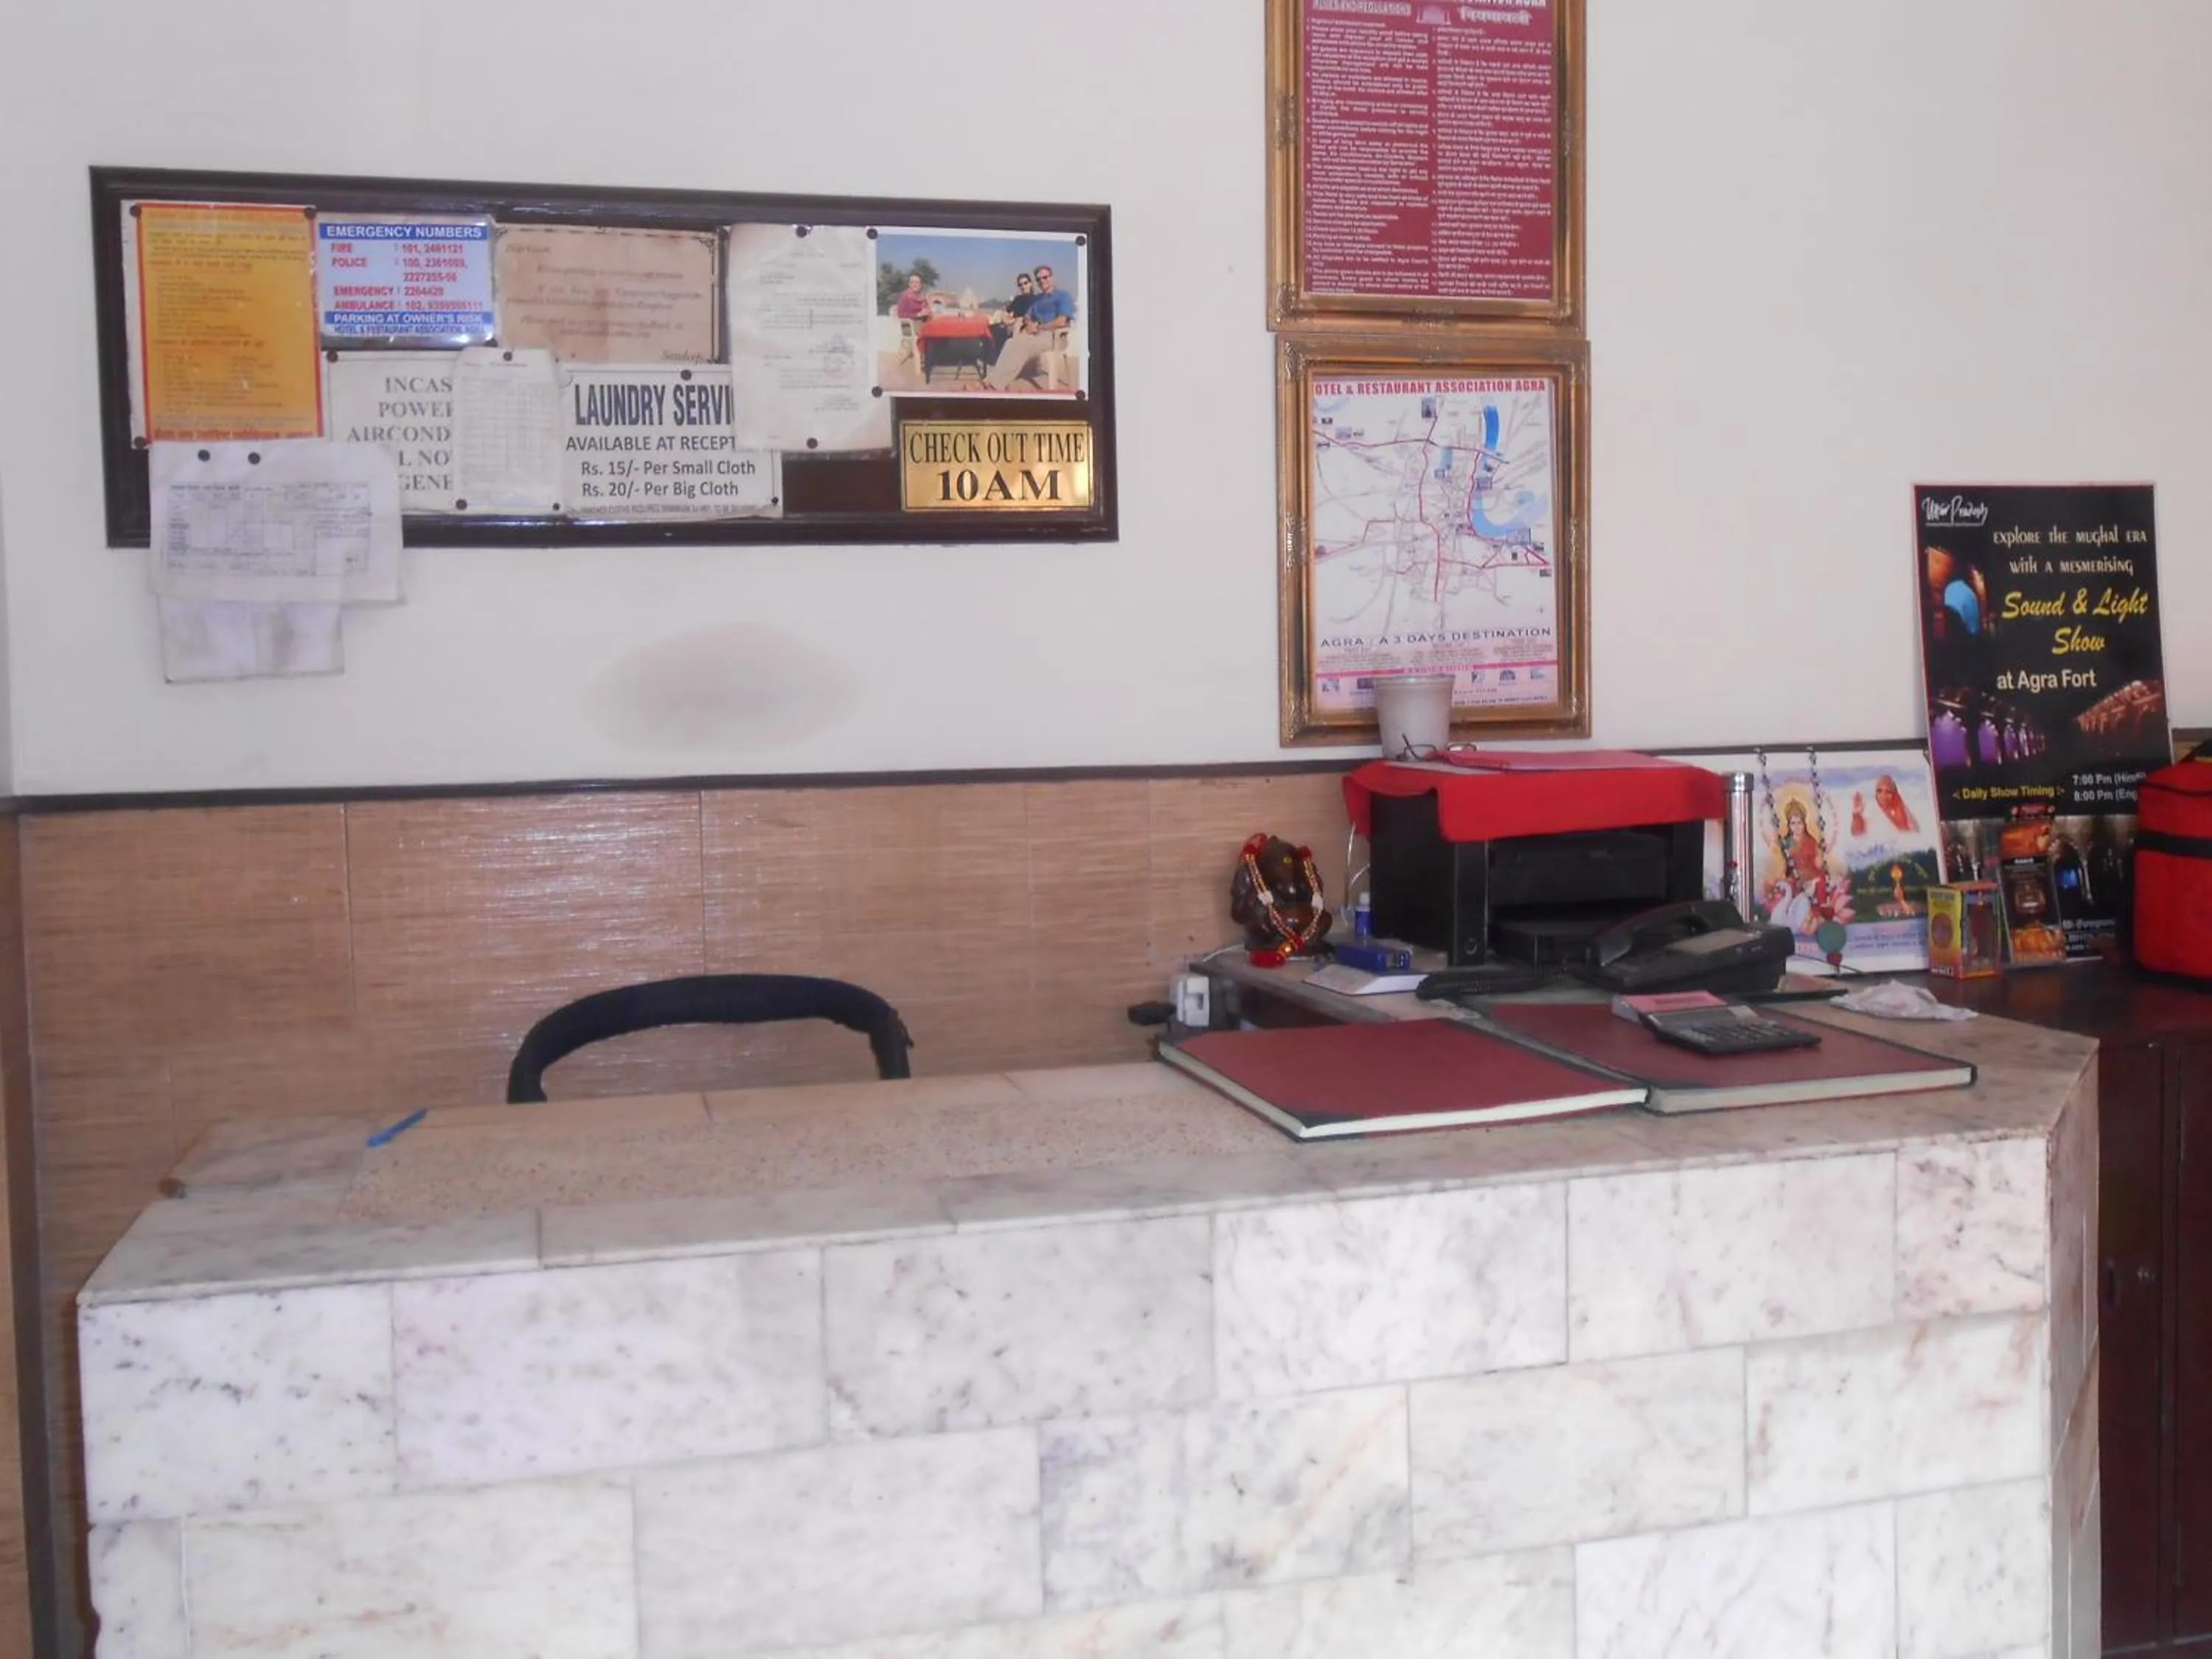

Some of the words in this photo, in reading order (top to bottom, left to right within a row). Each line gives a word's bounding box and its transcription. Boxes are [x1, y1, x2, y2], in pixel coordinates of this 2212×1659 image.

[327, 226, 411, 237] EMERGENCY
[415, 226, 481, 237] NUMBERS
[331, 243, 352, 253] FIRE
[332, 258, 366, 268] POLICE
[333, 286, 393, 296] EMERGENCY
[334, 300, 394, 310] AMBULANCE
[334, 313, 383, 323] PARKING
[386, 313, 399, 323] AT
[403, 313, 453, 323] OWNER'S
[457, 313, 483, 322] RISK
[1346, 386, 1354, 394] &
[1357, 381, 1431, 395] RESTAURANT
[1435, 380, 1512, 394] ASSOCIATION
[1515, 380, 1545, 392] AGRA
[575, 384, 665, 426] LAUNDRY
[672, 384, 734, 426] SERVI
[347, 426, 451, 442] AIRCOND
[566, 436, 650, 451] AVAILABLE
[656, 436, 675, 451] AT
[681, 437, 736, 451] RECEPT
[910, 432, 981, 464] CHECK
[987, 433, 1028, 463] OUT
[1034, 433, 1085, 462] TIME
[418, 450, 453, 466] NO
[581, 462, 603, 475] Rs.
[608, 461, 639, 478] 15/-
[644, 461, 666, 475] Per
[672, 460, 713, 475] Small
[717, 460, 756, 475] Cloth
[582, 483, 604, 496] Rs.
[608, 481, 639, 498] 20/-
[644, 482, 669, 496] Per
[673, 481, 696, 498] Big
[700, 481, 739, 495] Cloth
[2126, 530, 2147, 543] ERA
[2045, 561, 2053, 572] A
[2001, 591, 2066, 619] Sound
[2073, 588, 2087, 614] &
[2092, 587, 2149, 624] Light
[1321, 638, 1363, 648] AGRA
[1380, 635, 1389, 645] A
[1393, 636, 1402, 644] 3
[1408, 633, 1446, 644] DAYS
[1451, 627, 1551, 642] DESTINATION
[2052, 625, 2106, 655] Show
[1997, 671, 2014, 689] at
[2017, 669, 2058, 693] Agra
[2061, 667, 2097, 689] Fort
[2096, 773, 2112, 784] Pm
[1962, 787, 1988, 801] Daily
[1990, 787, 2018, 798] Show
[2020, 785, 2054, 799] Timing
[2097, 790, 2112, 801] Pm
